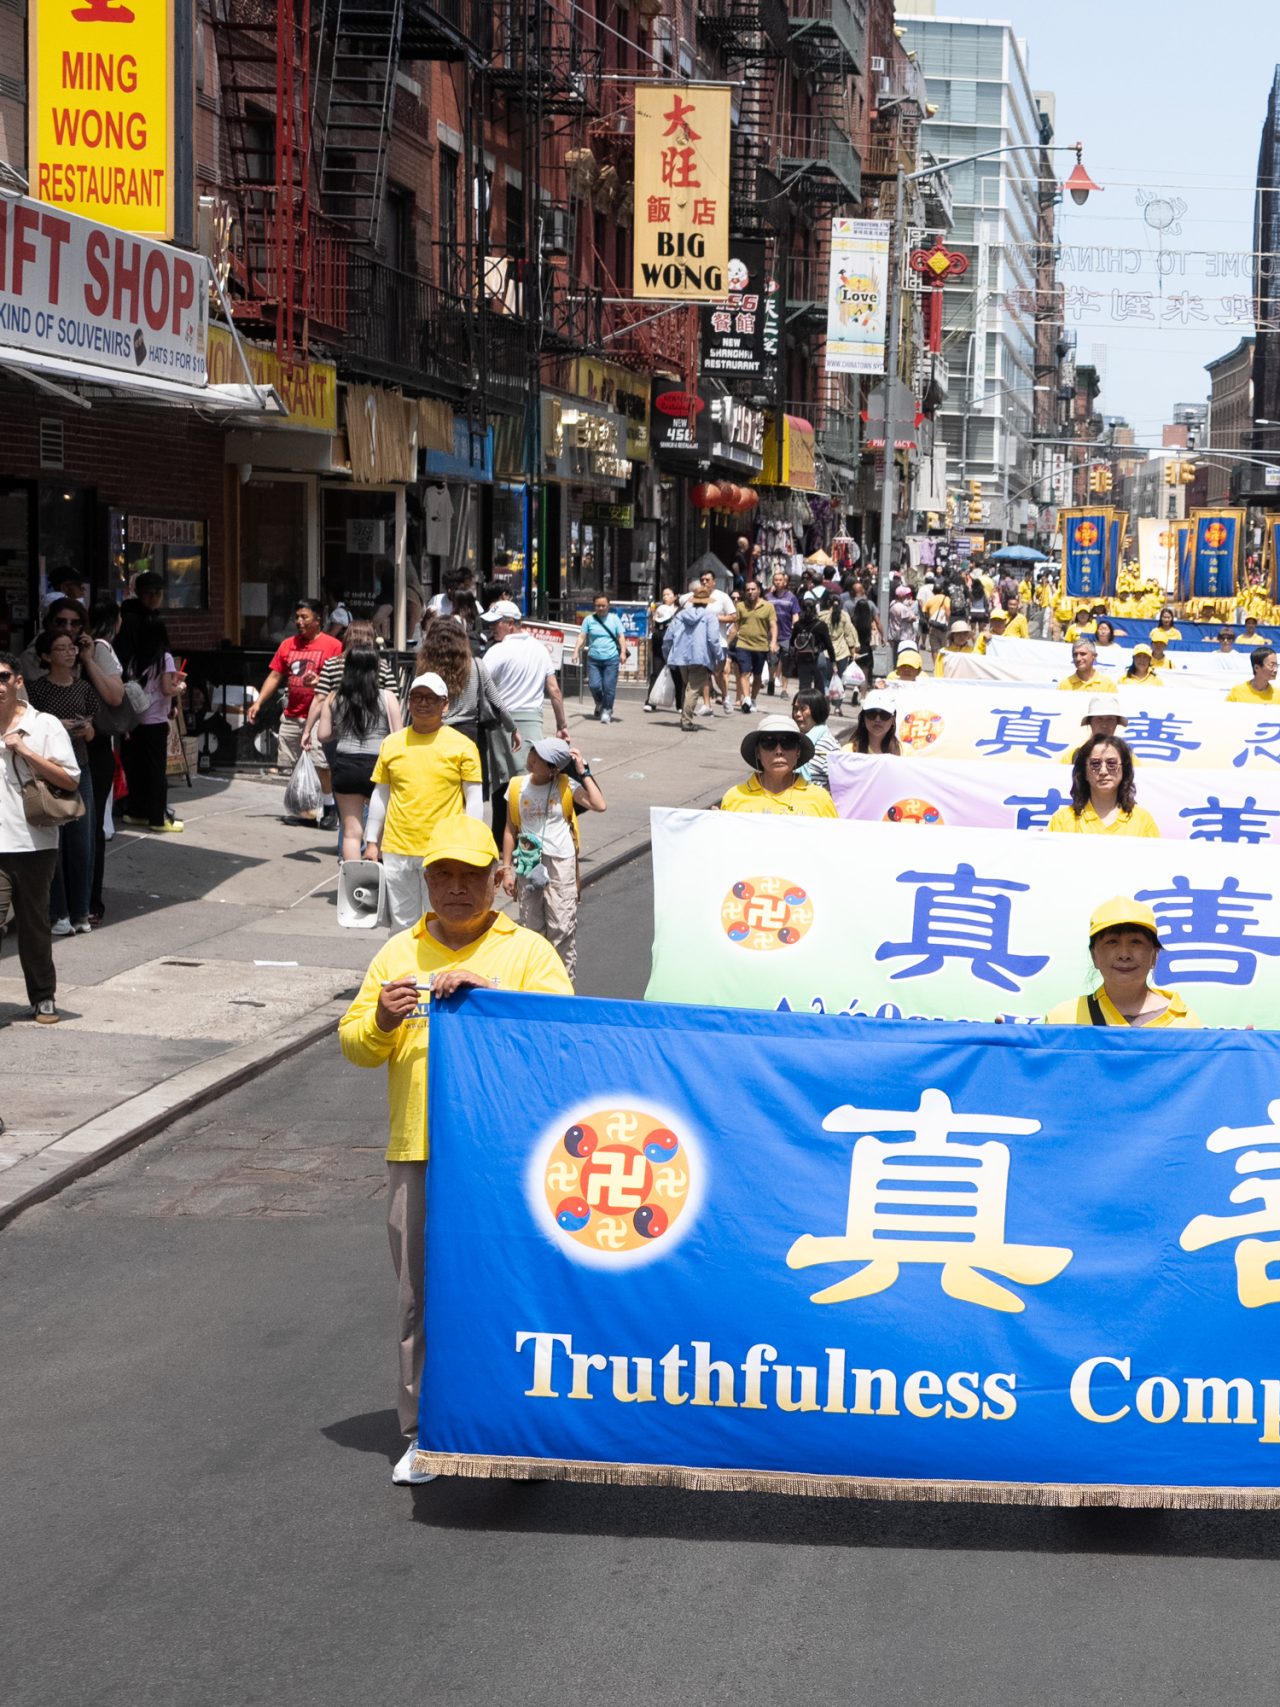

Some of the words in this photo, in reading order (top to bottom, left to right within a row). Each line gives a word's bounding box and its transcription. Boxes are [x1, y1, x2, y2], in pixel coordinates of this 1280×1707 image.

[62, 51, 137, 92] MING
[52, 108, 146, 151] WONG
[661, 94, 702, 189] 大旺
[39, 163, 164, 207] RESTAURANT
[647, 195, 716, 225] 飯店
[657, 231, 705, 258] BIG
[84, 229, 195, 337] SHOP
[641, 263, 722, 291] WONG
[842, 289, 878, 302] Love
[35, 311, 55, 341] OF
[58, 317, 131, 358] SOUVENIRS
[722, 338, 741, 347] NEW
[149, 344, 168, 364] HATS
[169, 350, 174, 367] 3
[176, 352, 191, 370] FOR
[193, 356, 205, 374] $10
[705, 359, 760, 371] RESTAURANT
[710, 349, 753, 359] SHANGHAI
[872, 439, 912, 449] PHAMACY
[515, 1331, 1018, 1421] Truthfulness
